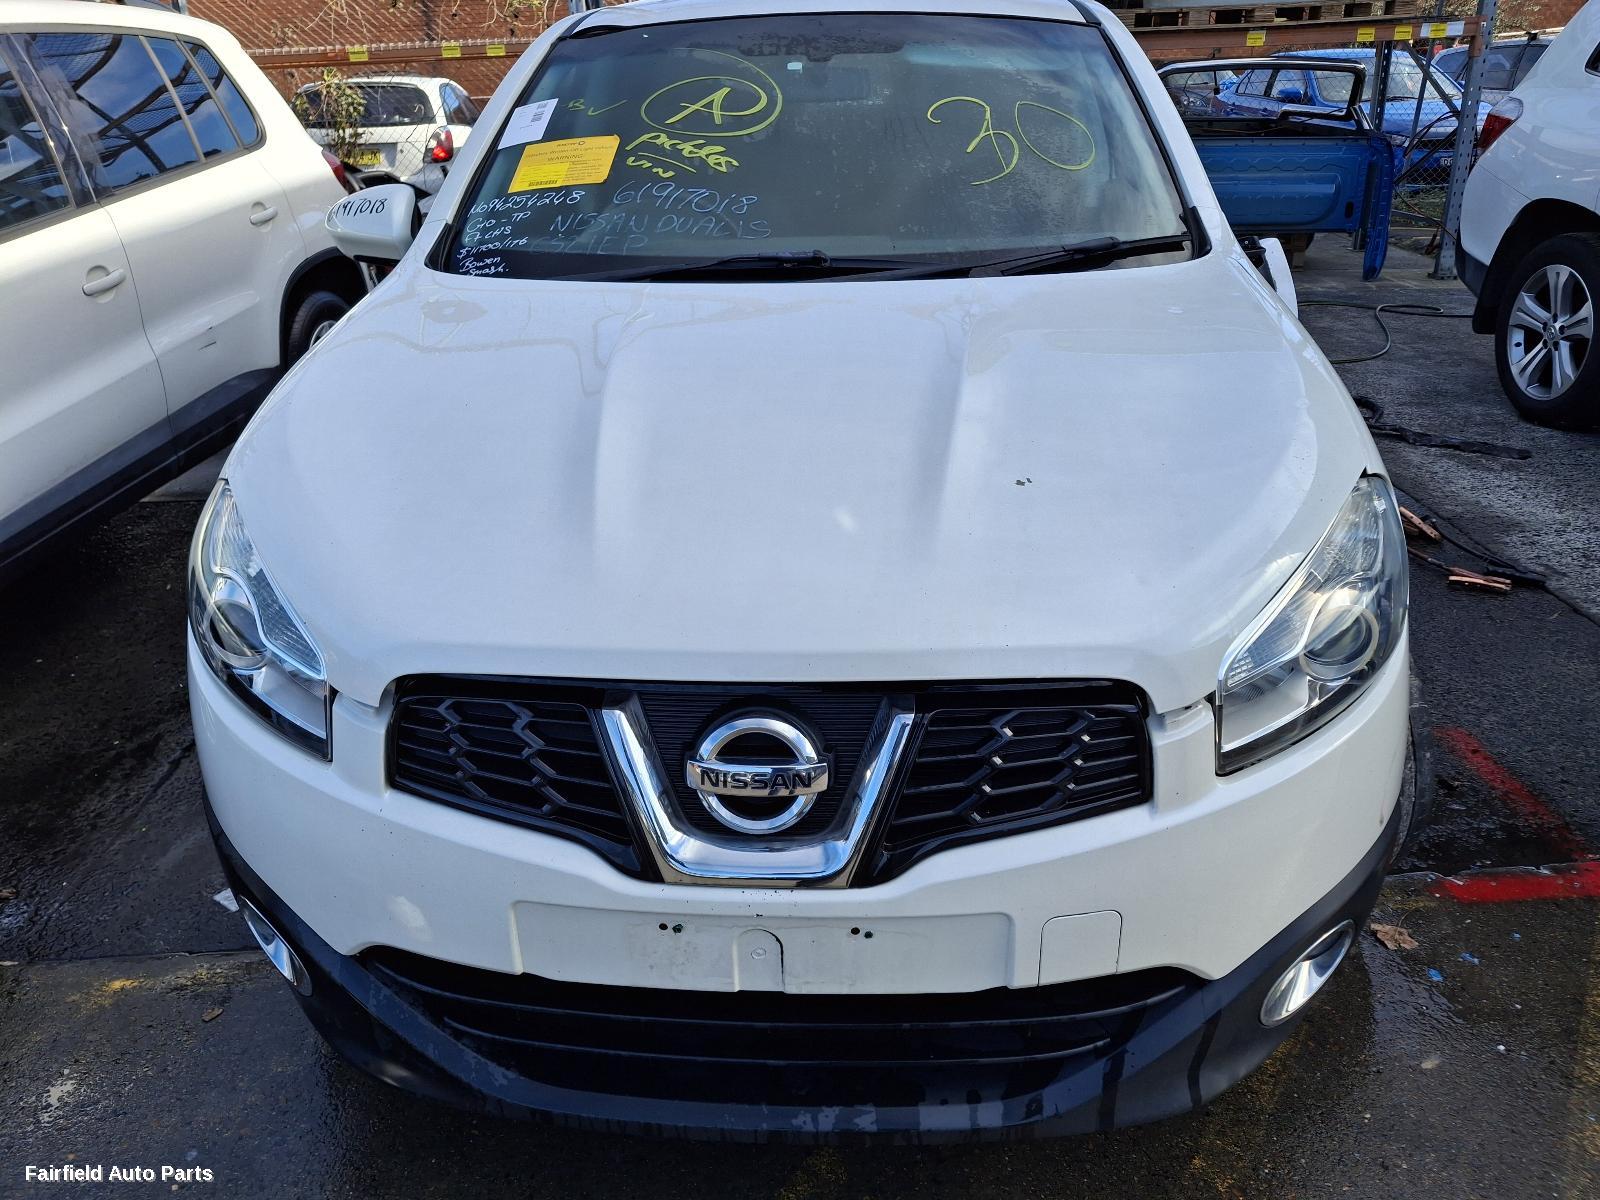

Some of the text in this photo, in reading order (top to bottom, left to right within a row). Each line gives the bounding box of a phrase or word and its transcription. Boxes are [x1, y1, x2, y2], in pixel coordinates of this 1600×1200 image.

[927, 96, 1096, 186] 30
[613, 181, 758, 214] 61917018
[549, 212, 771, 239] NISSAN DUALIS
[699, 768, 813, 790] NISSAN
